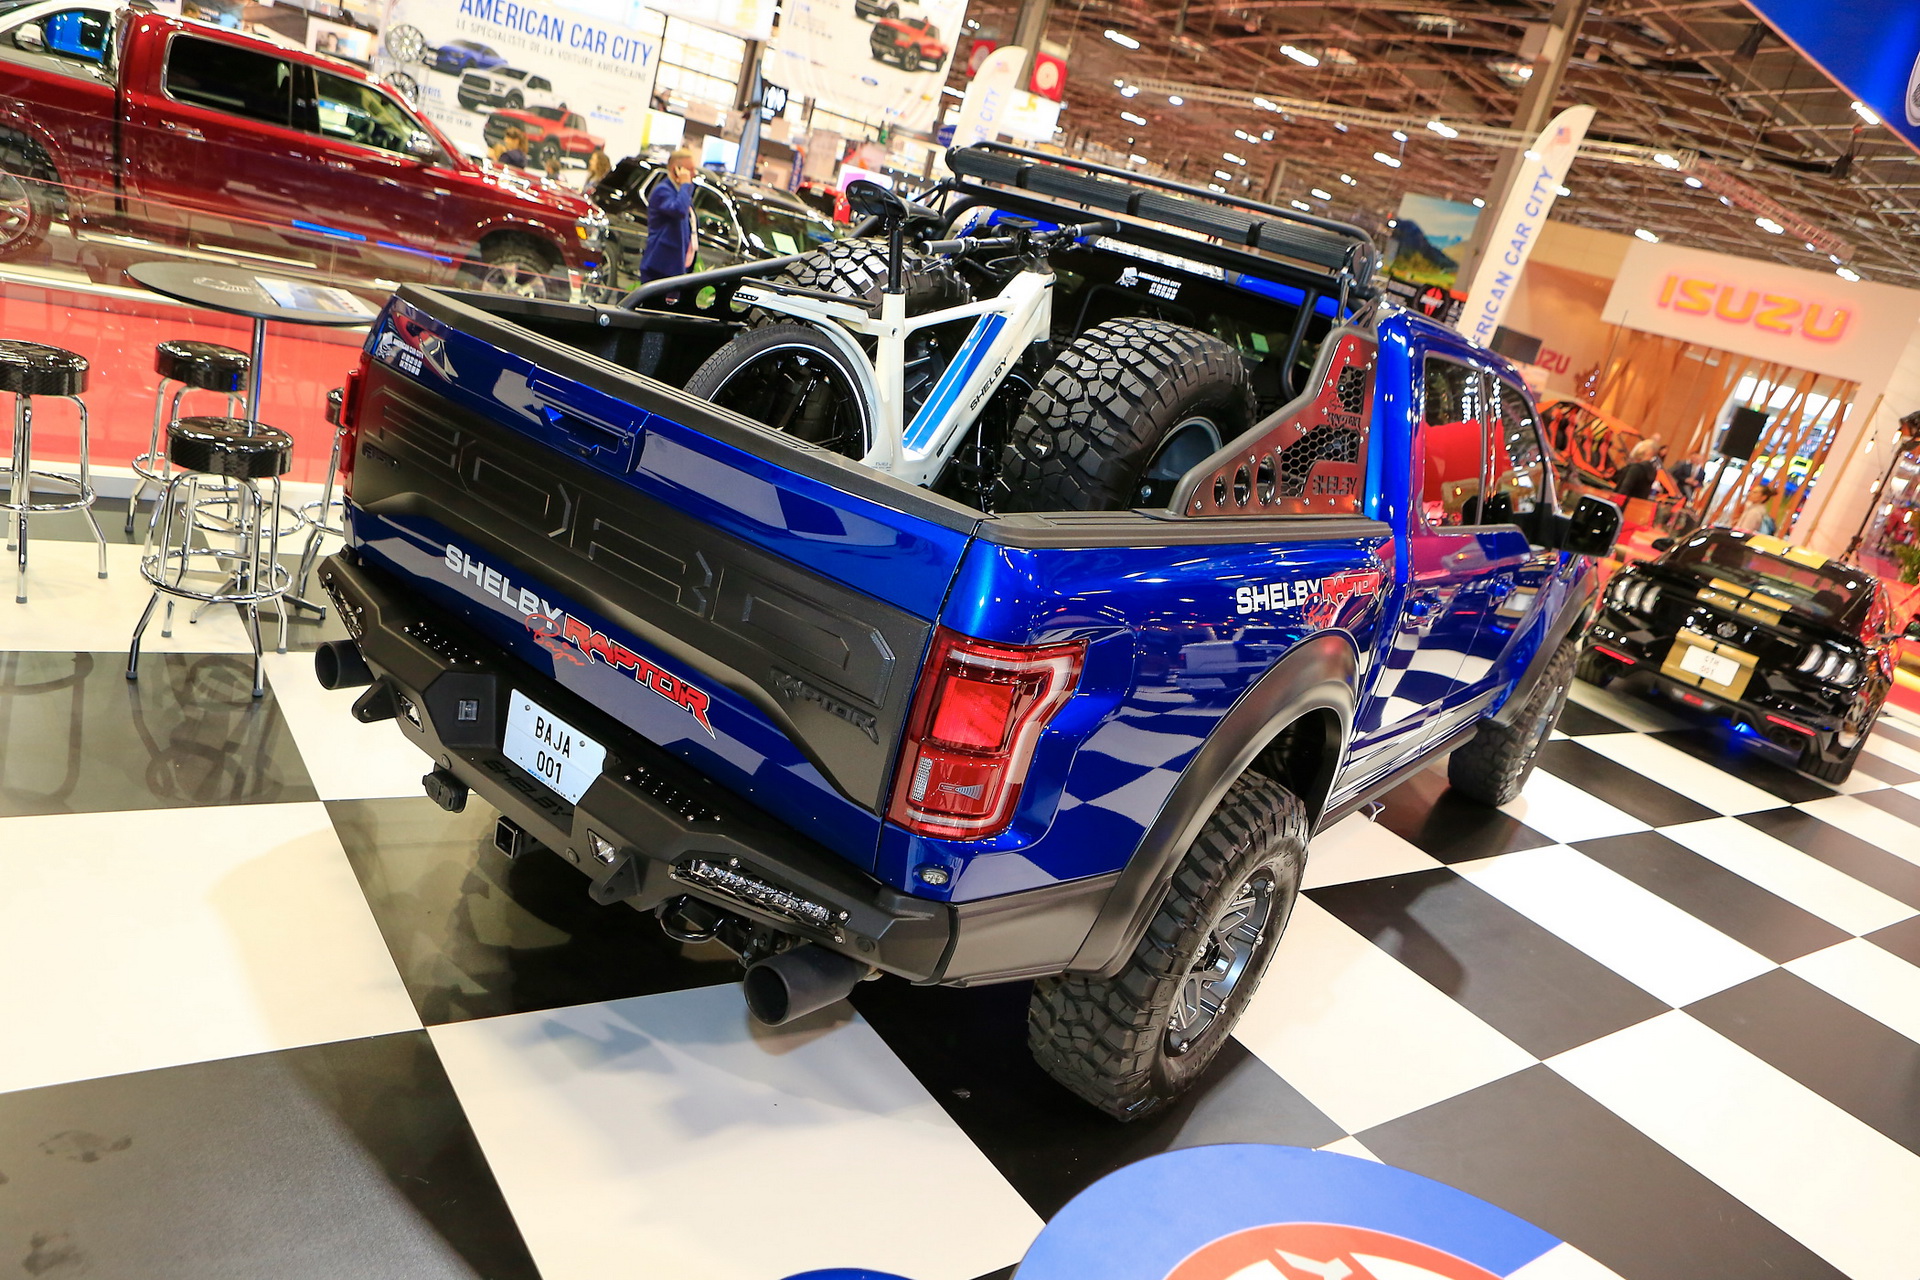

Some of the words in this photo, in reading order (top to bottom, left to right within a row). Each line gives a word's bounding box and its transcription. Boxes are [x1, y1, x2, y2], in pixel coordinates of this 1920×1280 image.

[459, 0, 565, 44] AMERICAN
[569, 23, 608, 56] CAR
[611, 35, 653, 67] CITY
[979, 87, 1001, 122] CITY
[1504, 221, 1532, 267] CAR
[1524, 165, 1554, 218] CITY
[1657, 273, 1852, 343] ISUZU
[970, 356, 1007, 411] SHELBY
[1312, 475, 1358, 496] SHELBY
[1236, 578, 1322, 614] SHELBY
[444, 543, 563, 630] SHELBY
[562, 612, 717, 741] RAPTOR
[768, 664, 880, 746] RAPTOR
[535, 715, 571, 758] BAJA
[484, 760, 574, 817] SHELBY
[536, 750, 562, 784] 001
